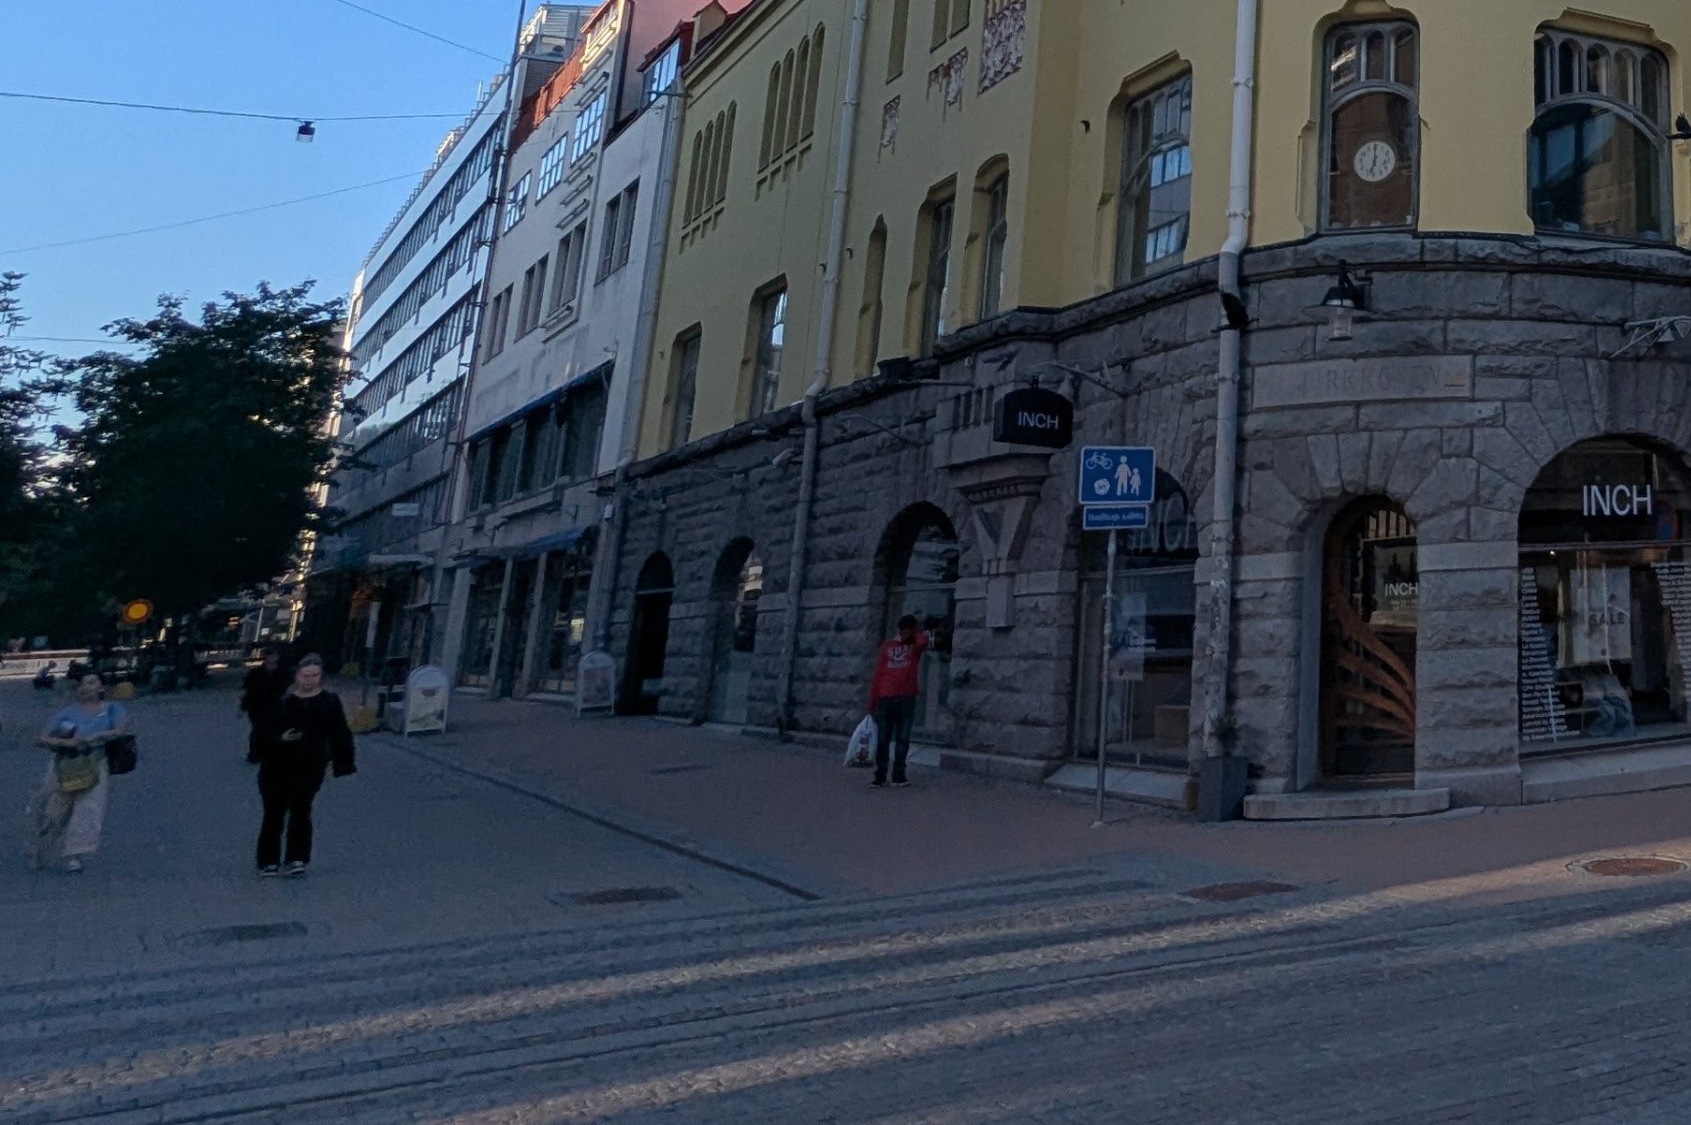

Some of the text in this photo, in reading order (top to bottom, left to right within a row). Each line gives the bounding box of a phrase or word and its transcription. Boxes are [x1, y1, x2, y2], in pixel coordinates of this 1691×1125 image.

[1017, 410, 1060, 430] INCH
[1583, 484, 1653, 516] INCH
[1384, 582, 1419, 597] INCH
